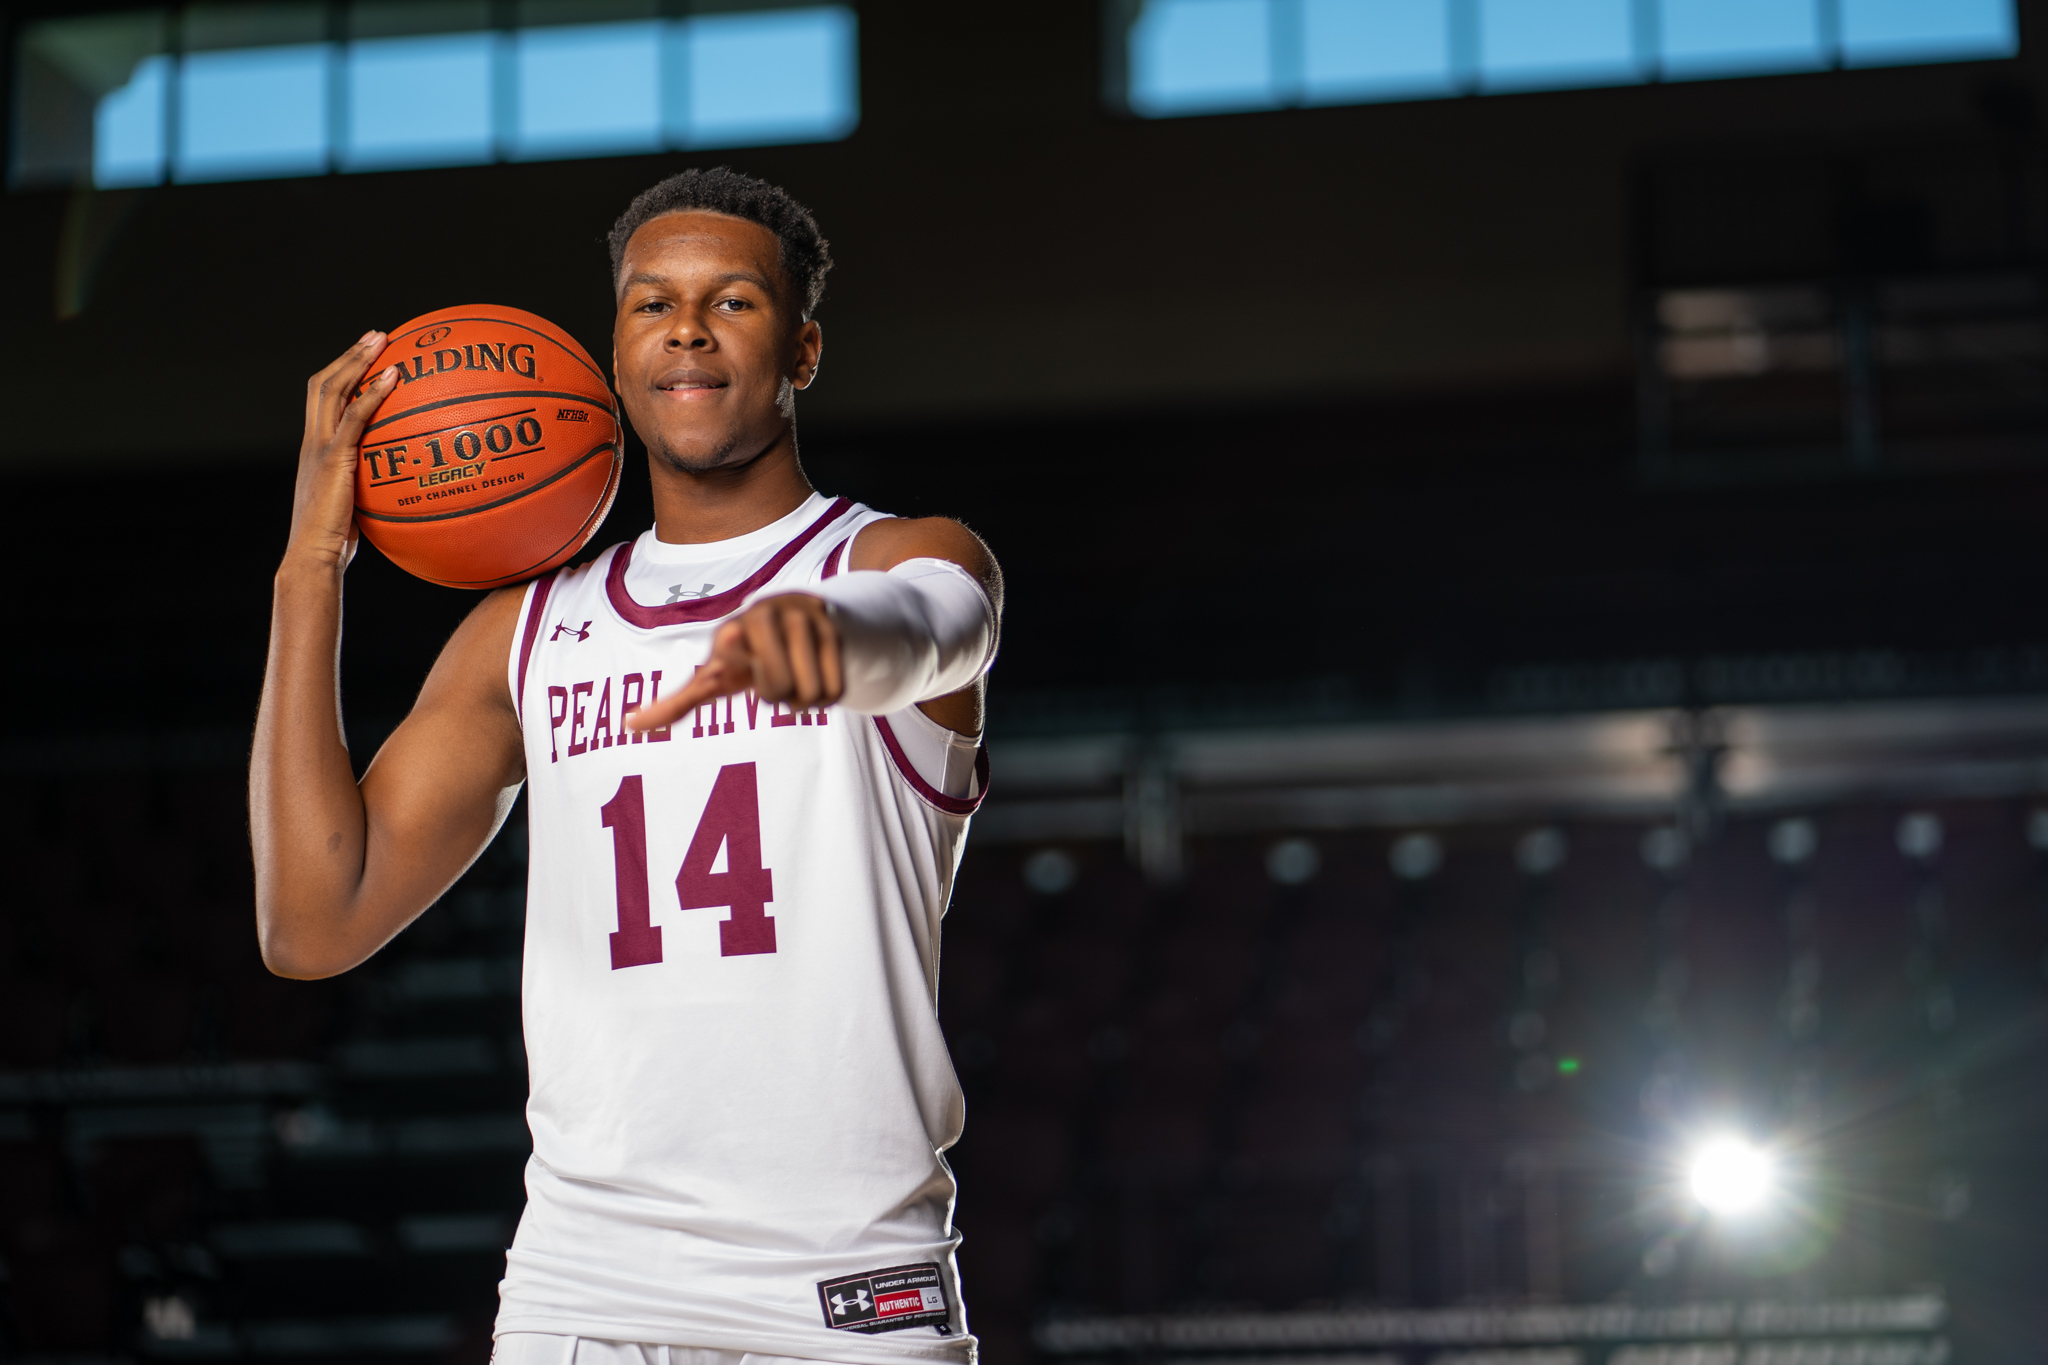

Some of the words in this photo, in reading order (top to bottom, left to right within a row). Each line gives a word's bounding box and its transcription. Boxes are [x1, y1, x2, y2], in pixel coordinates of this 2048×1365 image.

[354, 342, 537, 398] ALDING
[363, 416, 543, 480] TF-1000
[397, 495, 422, 506] DEEP
[426, 484, 477, 500] CHANNEL
[482, 472, 525, 489] DESIGN
[418, 460, 487, 489] LEGACY
[600, 760, 777, 971] 14
[875, 1279, 905, 1289] UNDER
[907, 1275, 936, 1284] ARMOUR
[879, 1297, 921, 1312] AUTHENTIC
[926, 1296, 938, 1304] LG
[869, 1317, 904, 1326] GUARANTEE
